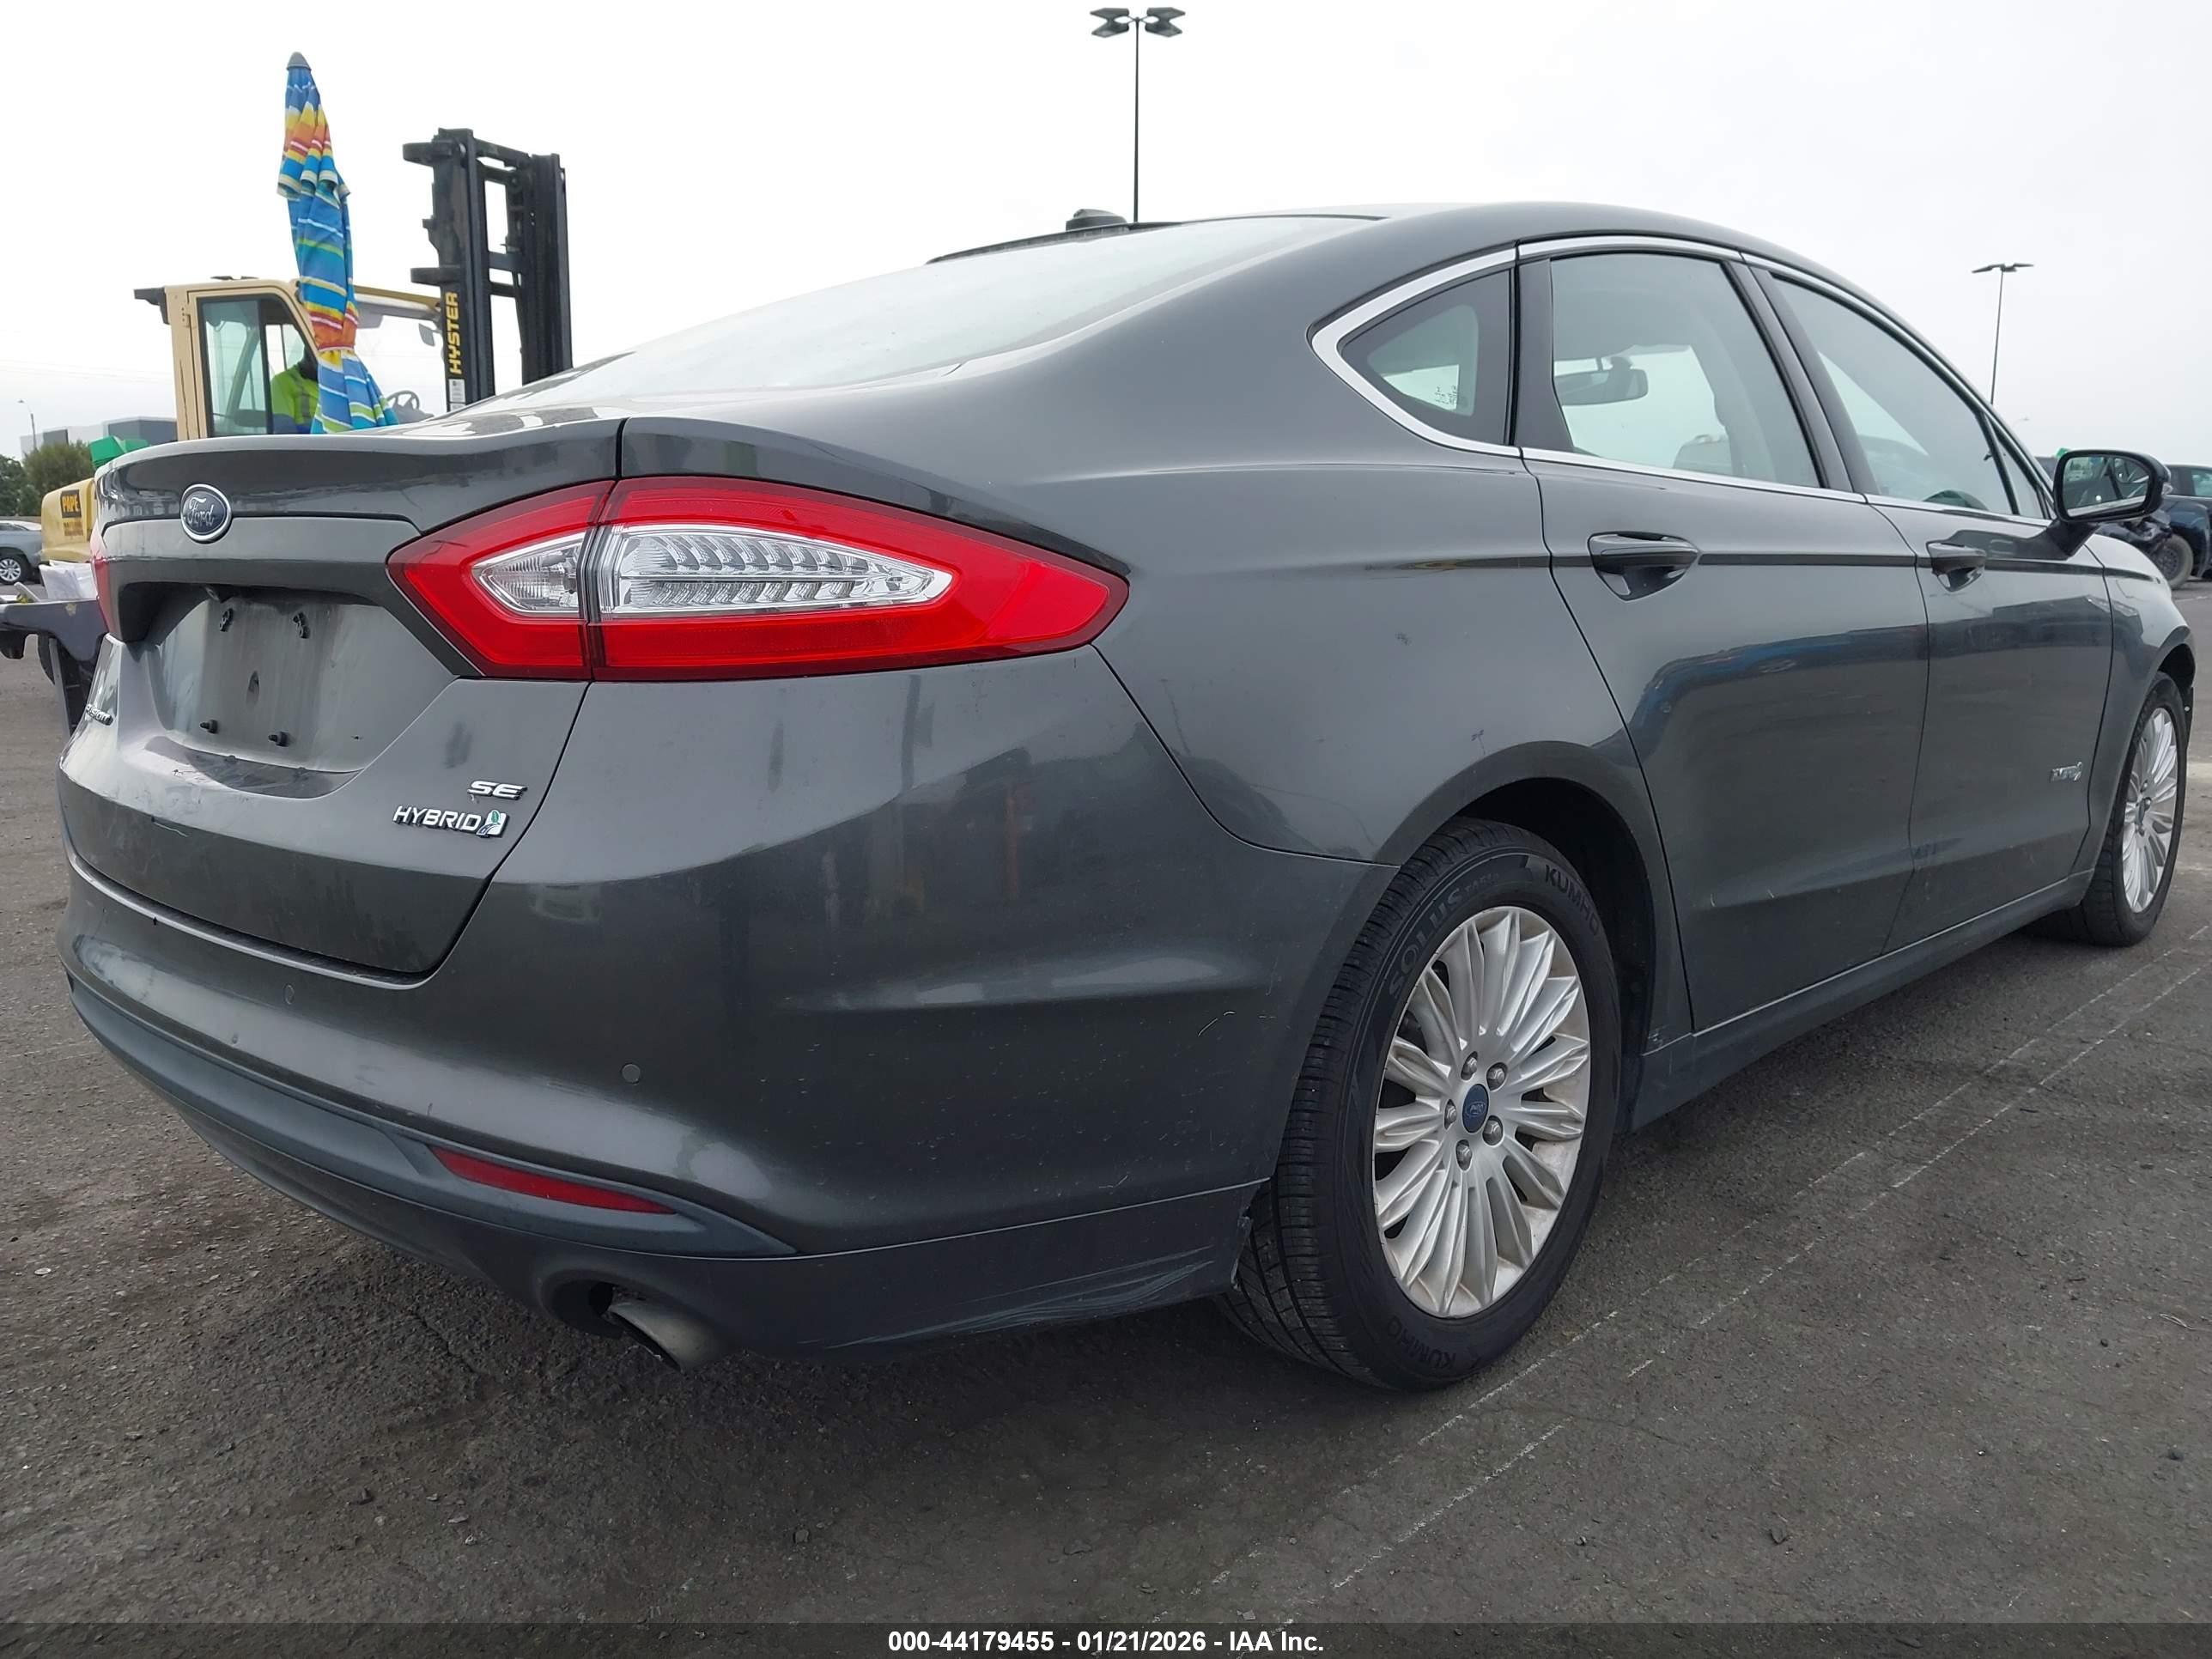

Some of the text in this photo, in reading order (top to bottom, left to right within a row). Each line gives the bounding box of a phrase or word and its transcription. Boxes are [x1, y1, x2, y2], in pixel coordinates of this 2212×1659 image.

[446, 292, 462, 374] HYSTER
[187, 496, 215, 526] Ford
[467, 781, 527, 799] SE
[392, 805, 482, 831] HYBRID
[1546, 864, 1600, 936] KUMHO
[1389, 887, 1462, 1000] SOLUS
